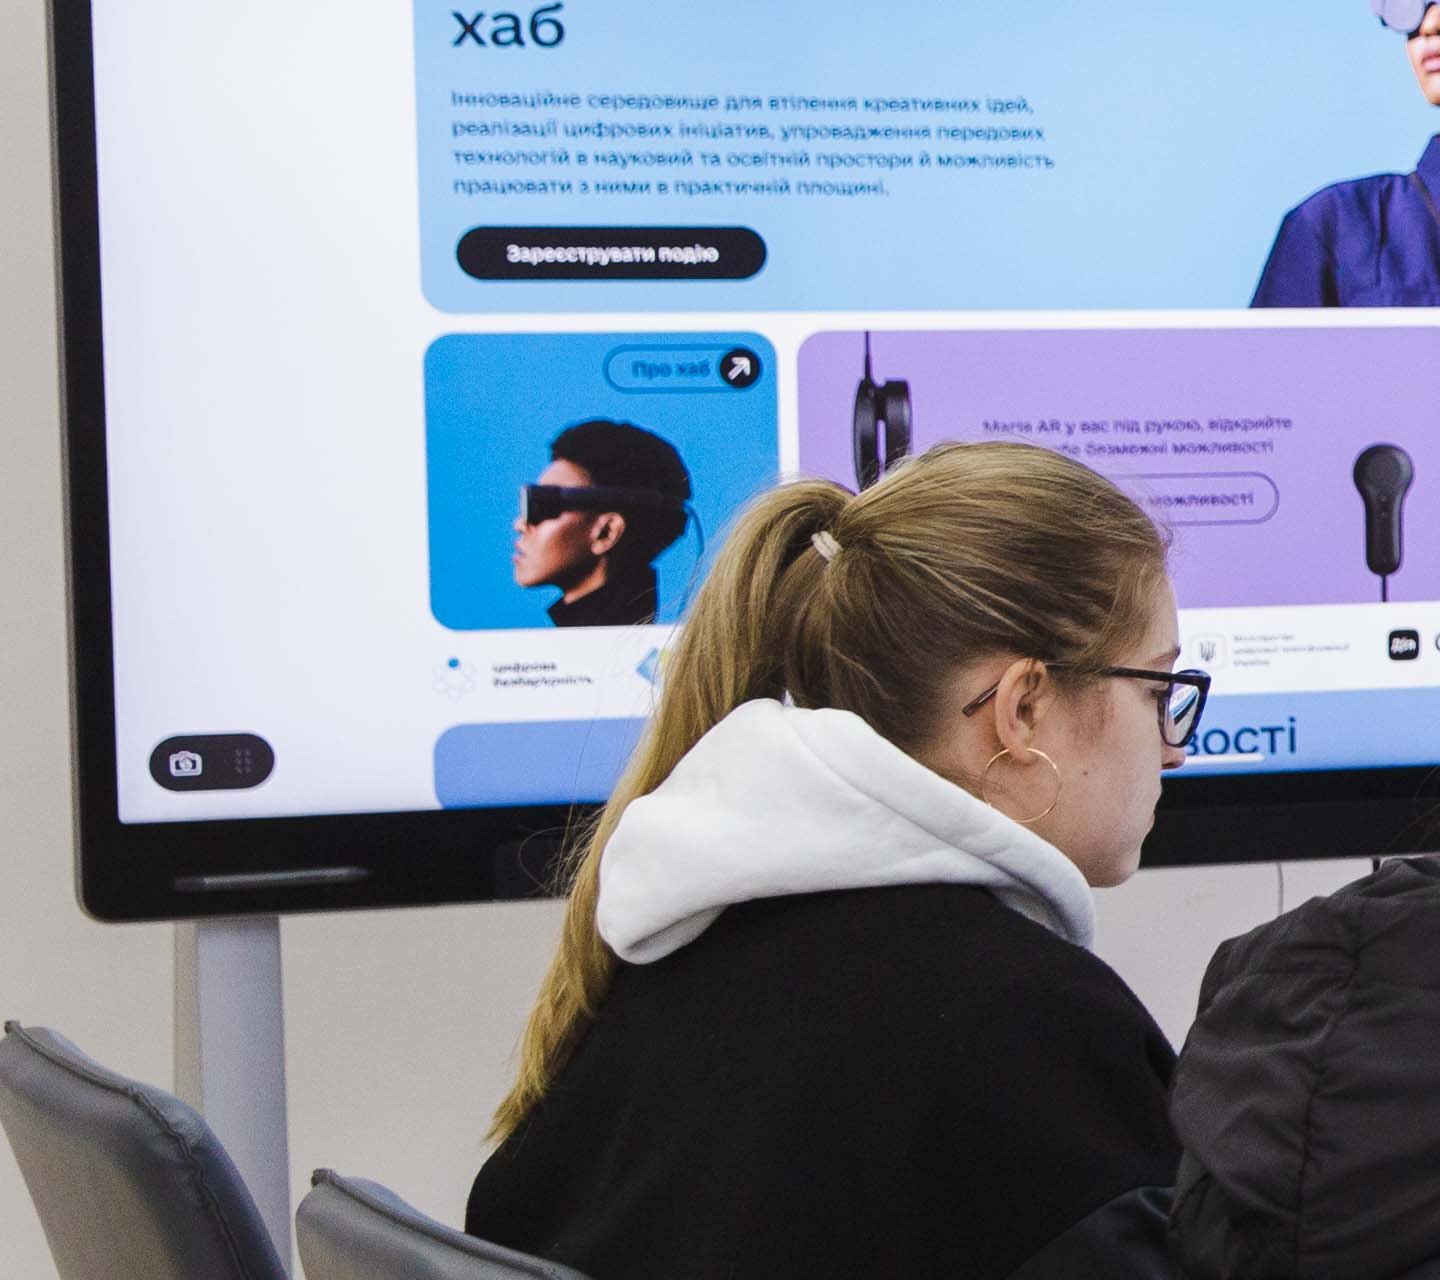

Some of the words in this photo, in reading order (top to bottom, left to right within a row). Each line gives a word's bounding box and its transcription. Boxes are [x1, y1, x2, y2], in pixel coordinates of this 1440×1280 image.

[452, 2, 565, 48] хаб
[451, 90, 582, 110] Інноваційне
[588, 94, 718, 111] середовище
[726, 95, 763, 111] для
[701, 152, 720, 166] та
[631, 360, 670, 381] Про
[674, 358, 711, 379] хаб
